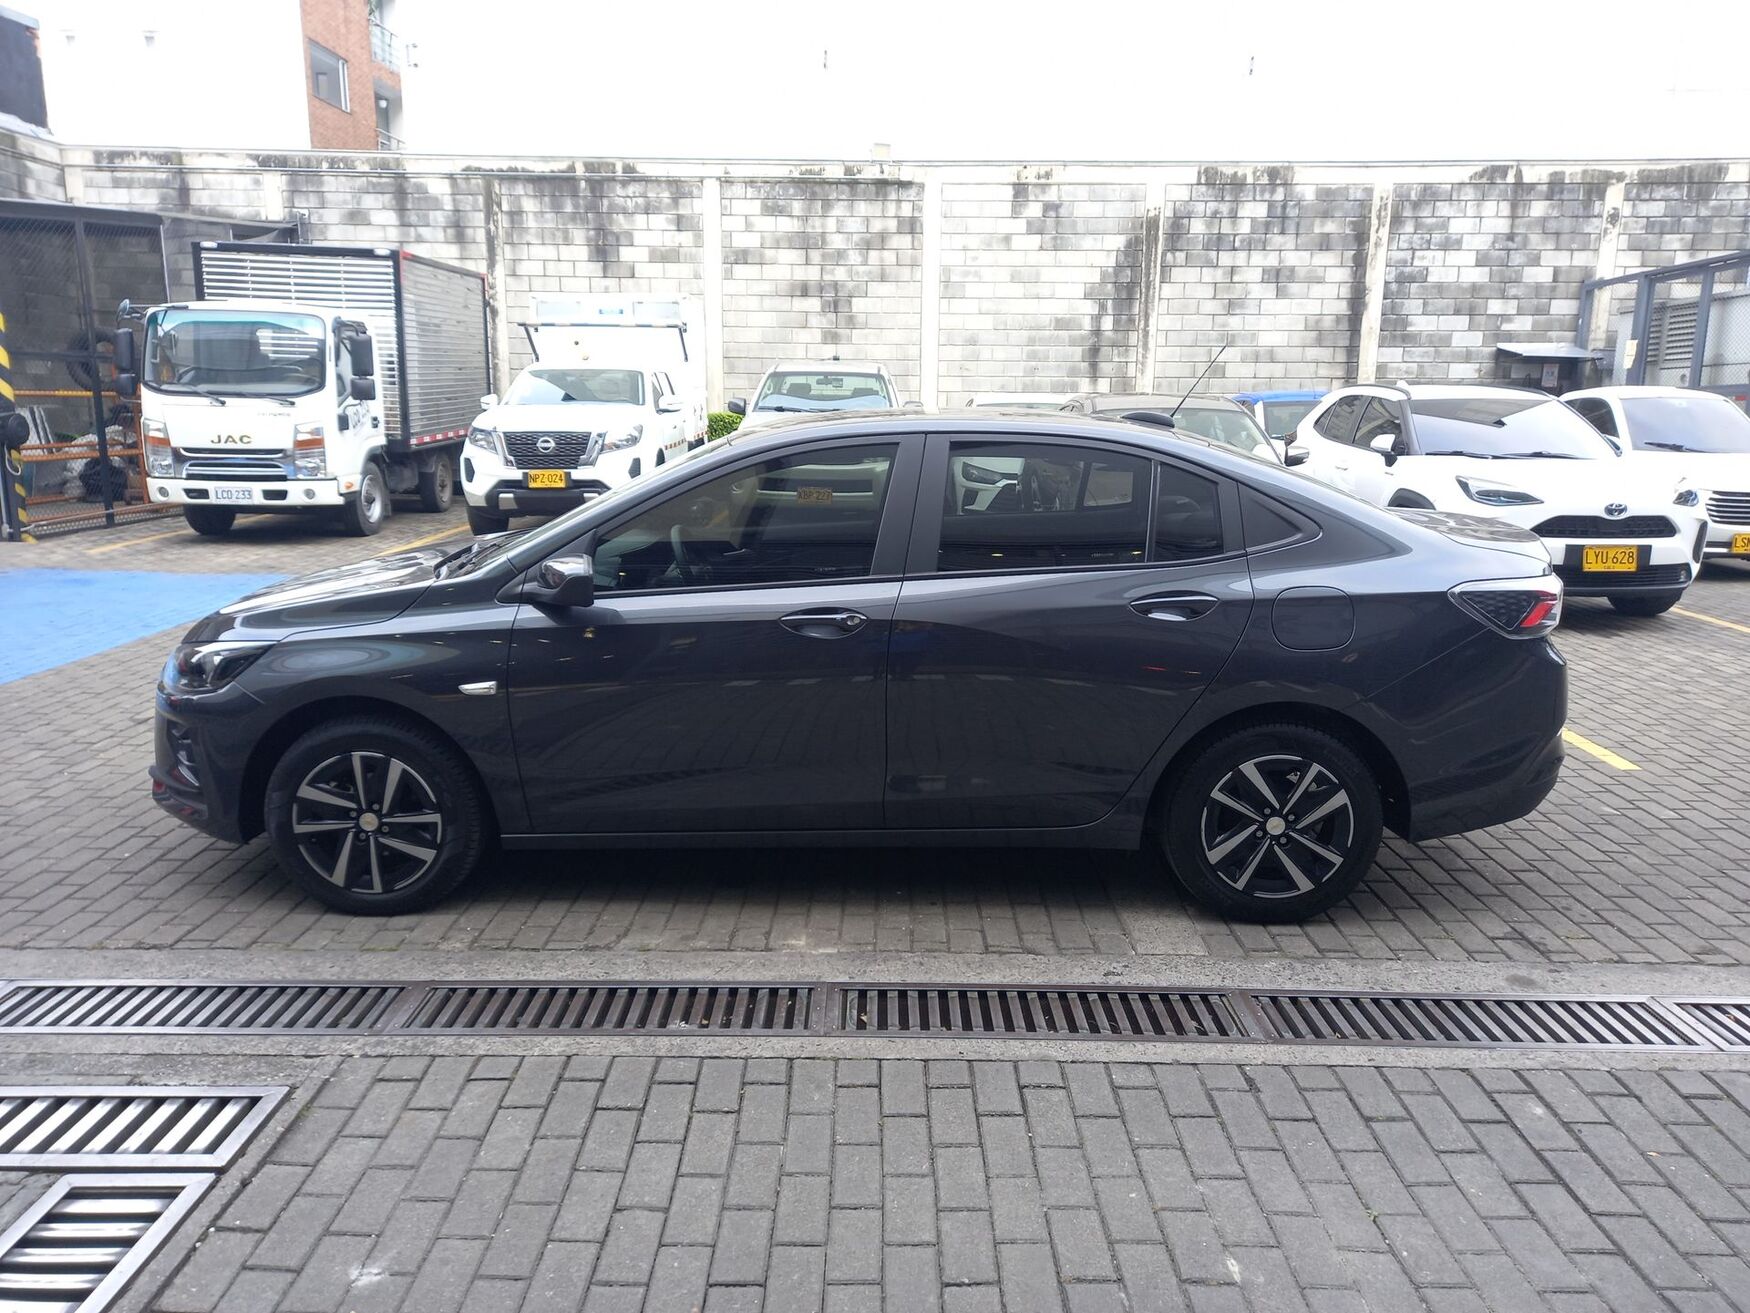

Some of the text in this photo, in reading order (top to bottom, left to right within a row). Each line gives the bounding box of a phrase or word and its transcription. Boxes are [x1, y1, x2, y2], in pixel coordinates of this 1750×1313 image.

[210, 434, 252, 444] JAC
[235, 489, 251, 500] 233
[1585, 550, 1635, 564] LYU 628
